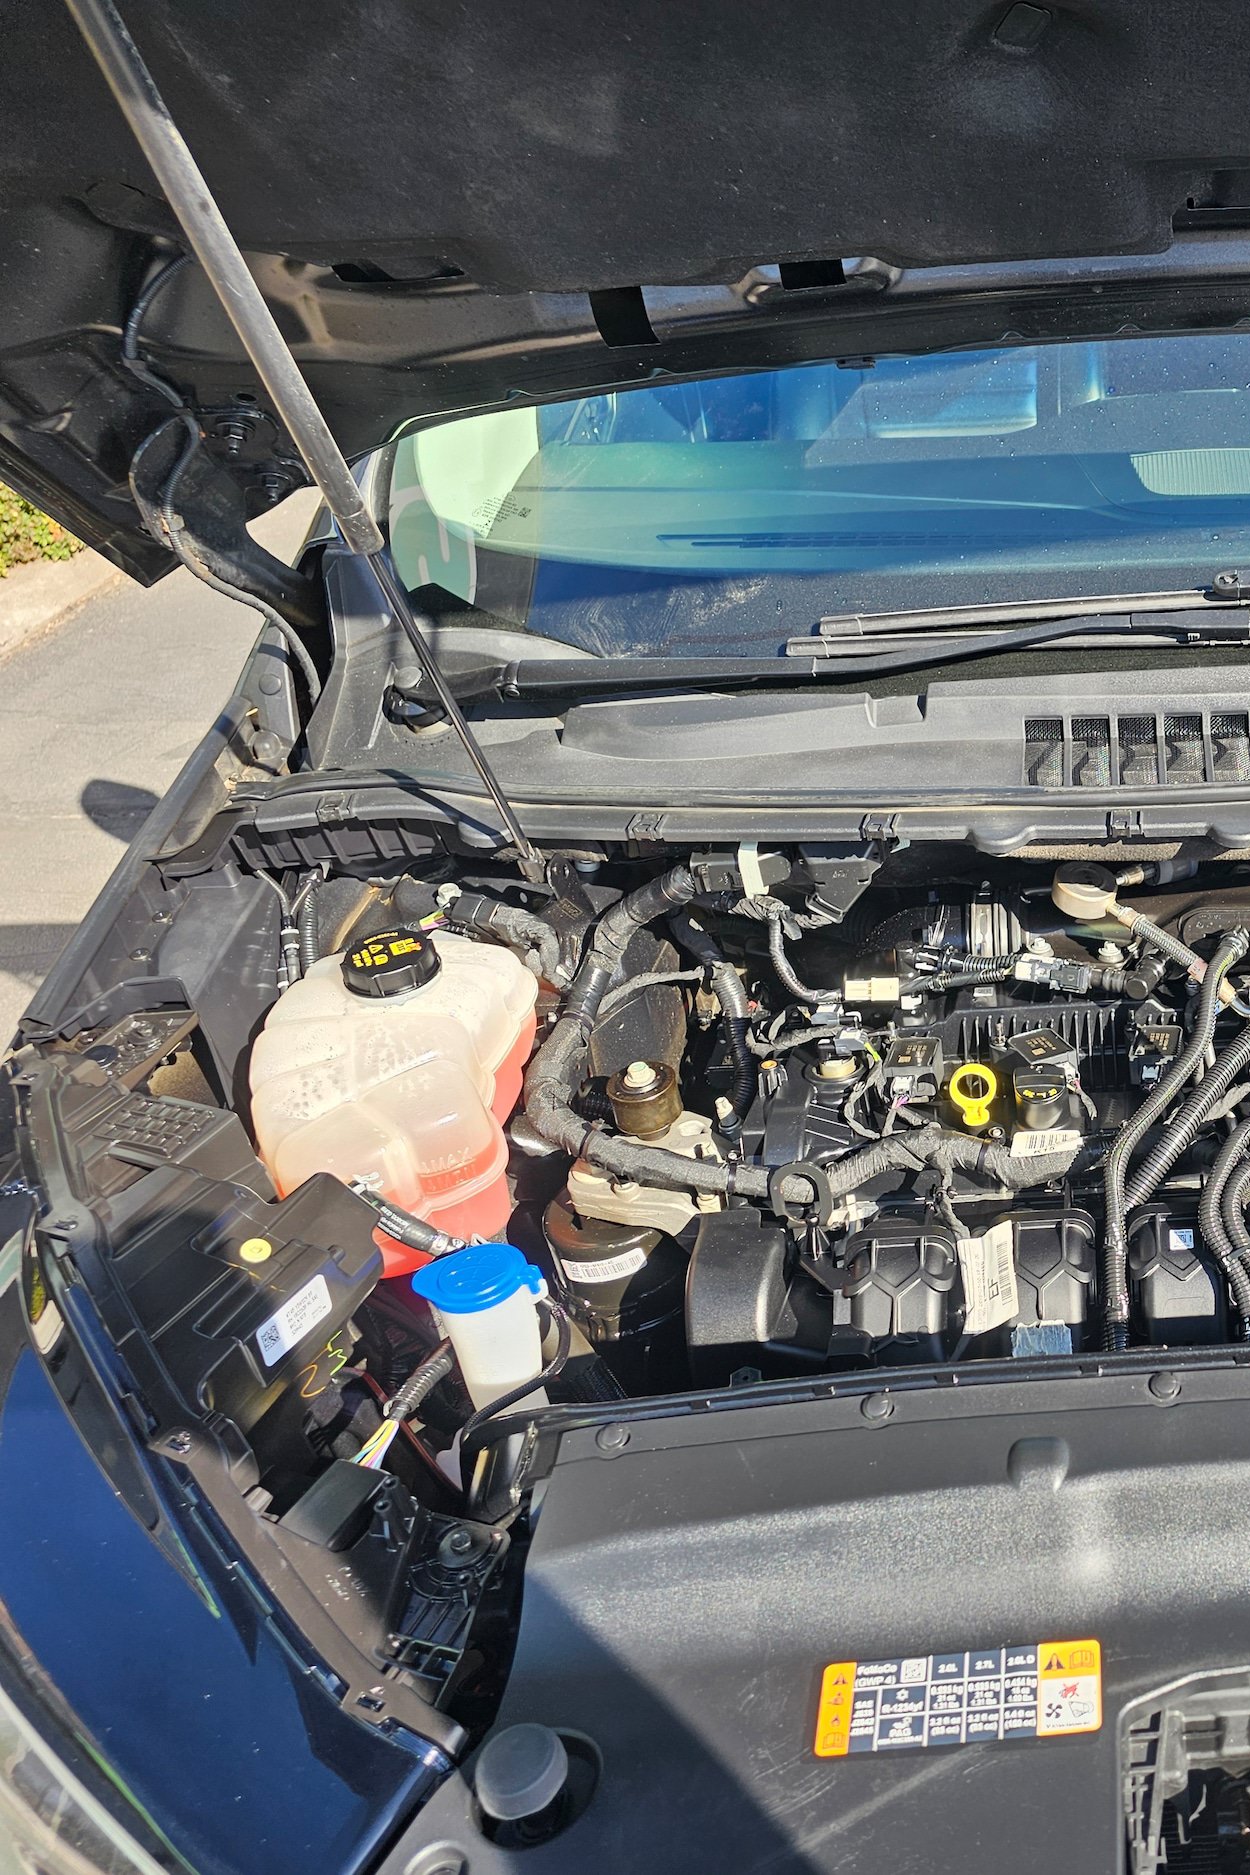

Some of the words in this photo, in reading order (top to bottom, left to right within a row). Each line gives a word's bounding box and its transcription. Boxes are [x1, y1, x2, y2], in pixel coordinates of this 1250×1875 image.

[857, 1664, 898, 1676] FoMoCo
[855, 1676, 884, 1688] (GWP
[889, 1728, 912, 1738] PAG
